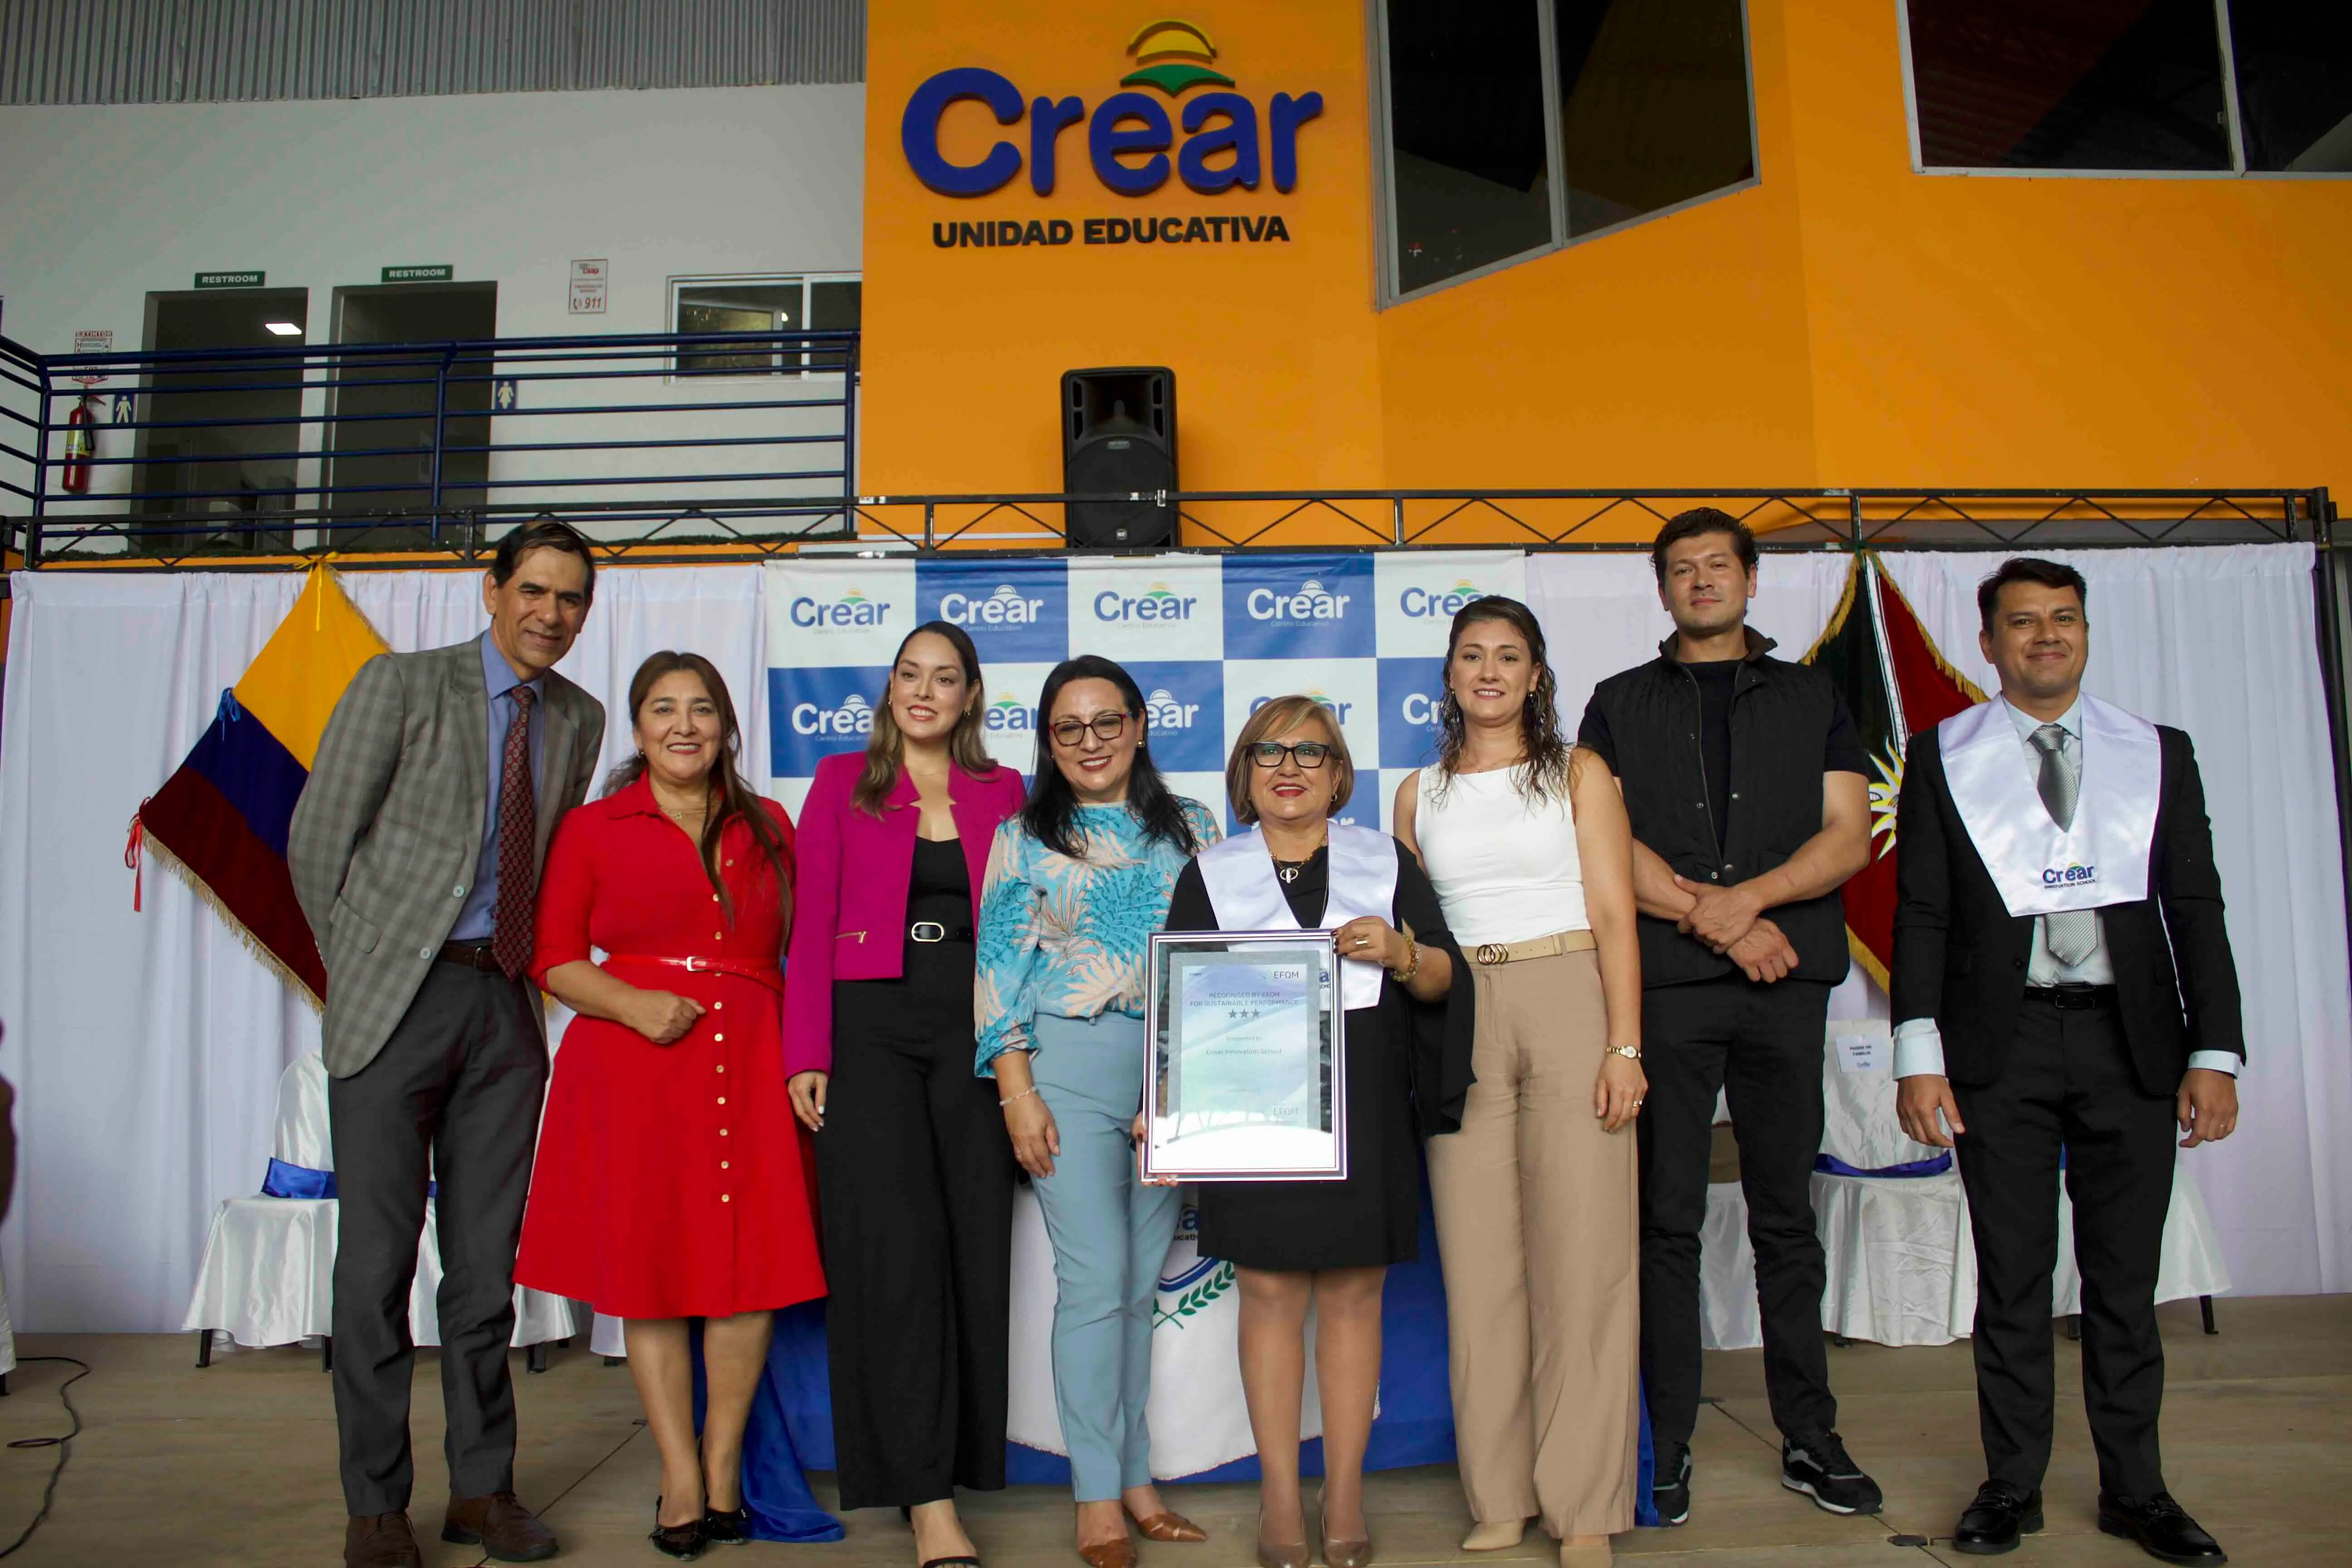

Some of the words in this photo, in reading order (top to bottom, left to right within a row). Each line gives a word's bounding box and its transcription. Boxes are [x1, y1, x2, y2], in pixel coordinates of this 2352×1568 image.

[902, 68, 1323, 198] Crear
[932, 220, 1073, 247] UNIDAD
[1083, 216, 1289, 245] EDUCATIVA
[202, 275, 258, 283] RESTROOM
[388, 269, 446, 278] RESTROOM
[583, 297, 602, 309] 911
[791, 597, 891, 627] Crear
[941, 593, 1044, 624] Crear
[1094, 591, 1197, 622] Crear
[1247, 588, 1351, 620] Crear
[1401, 588, 1502, 617] Cre
[792, 703, 874, 734] Crea
[984, 708, 1039, 730] ear
[1147, 703, 1199, 729] ear
[2043, 866, 2094, 883] Crear
